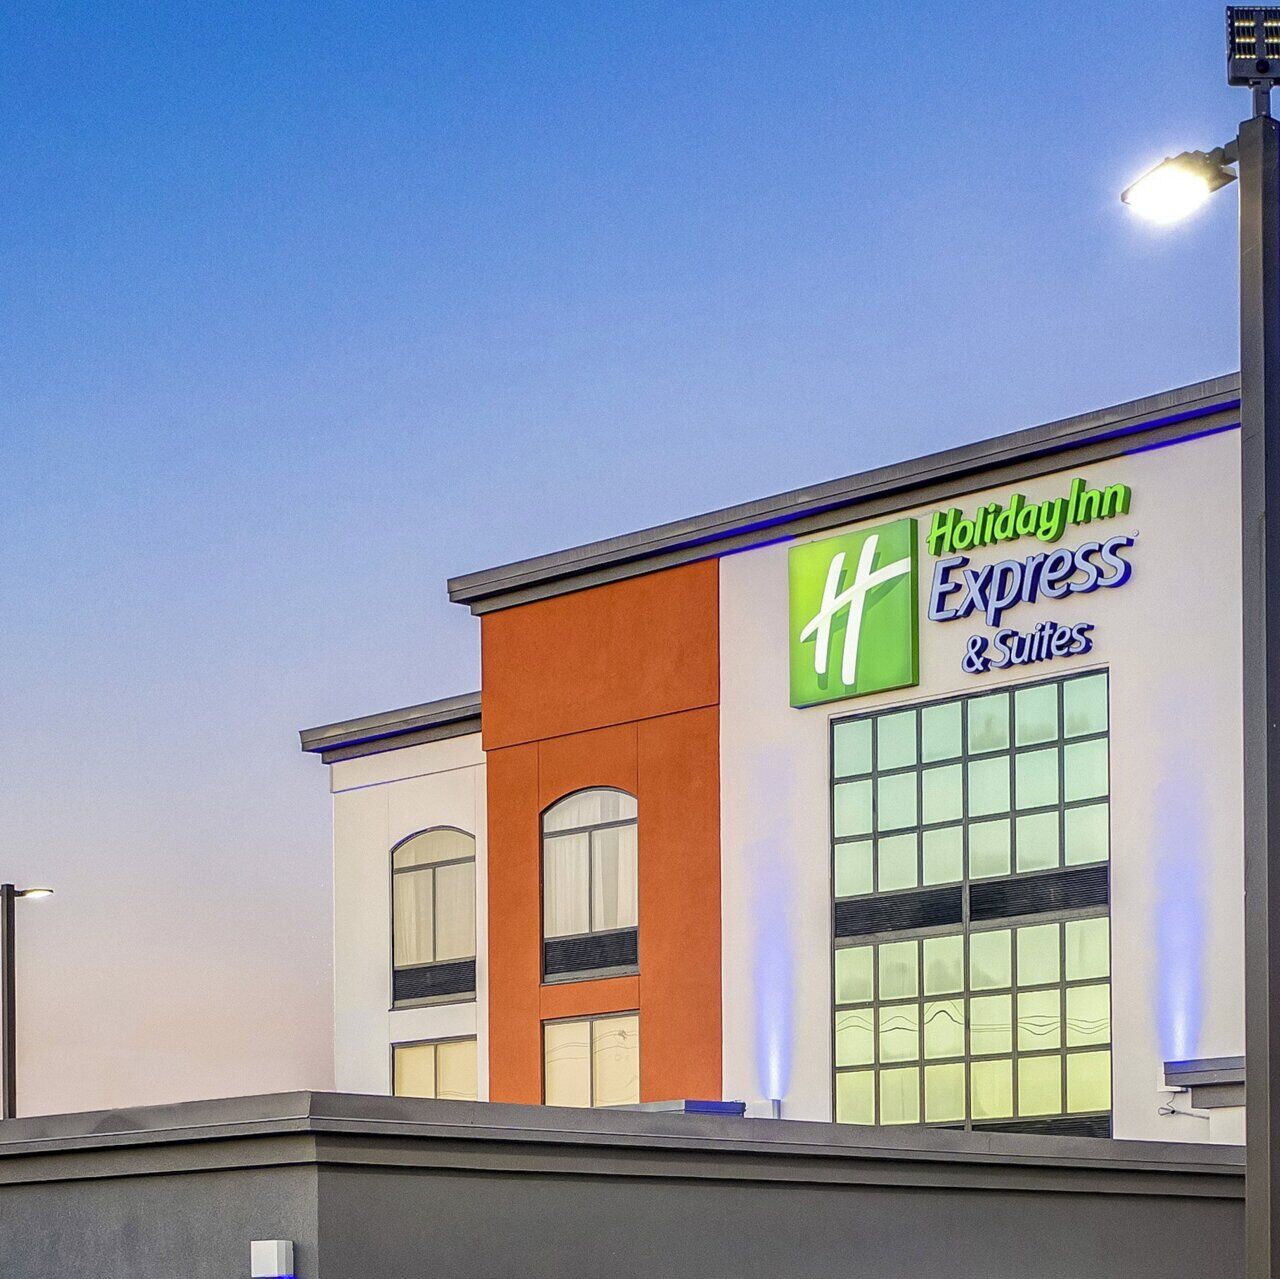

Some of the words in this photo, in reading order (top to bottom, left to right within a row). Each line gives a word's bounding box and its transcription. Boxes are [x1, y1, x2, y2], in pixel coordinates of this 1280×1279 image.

[926, 493, 1066, 557] Holiday
[1067, 477, 1132, 524] Inn
[927, 535, 1134, 627] Express
[961, 633, 989, 674] &
[990, 621, 1095, 669] Suites
